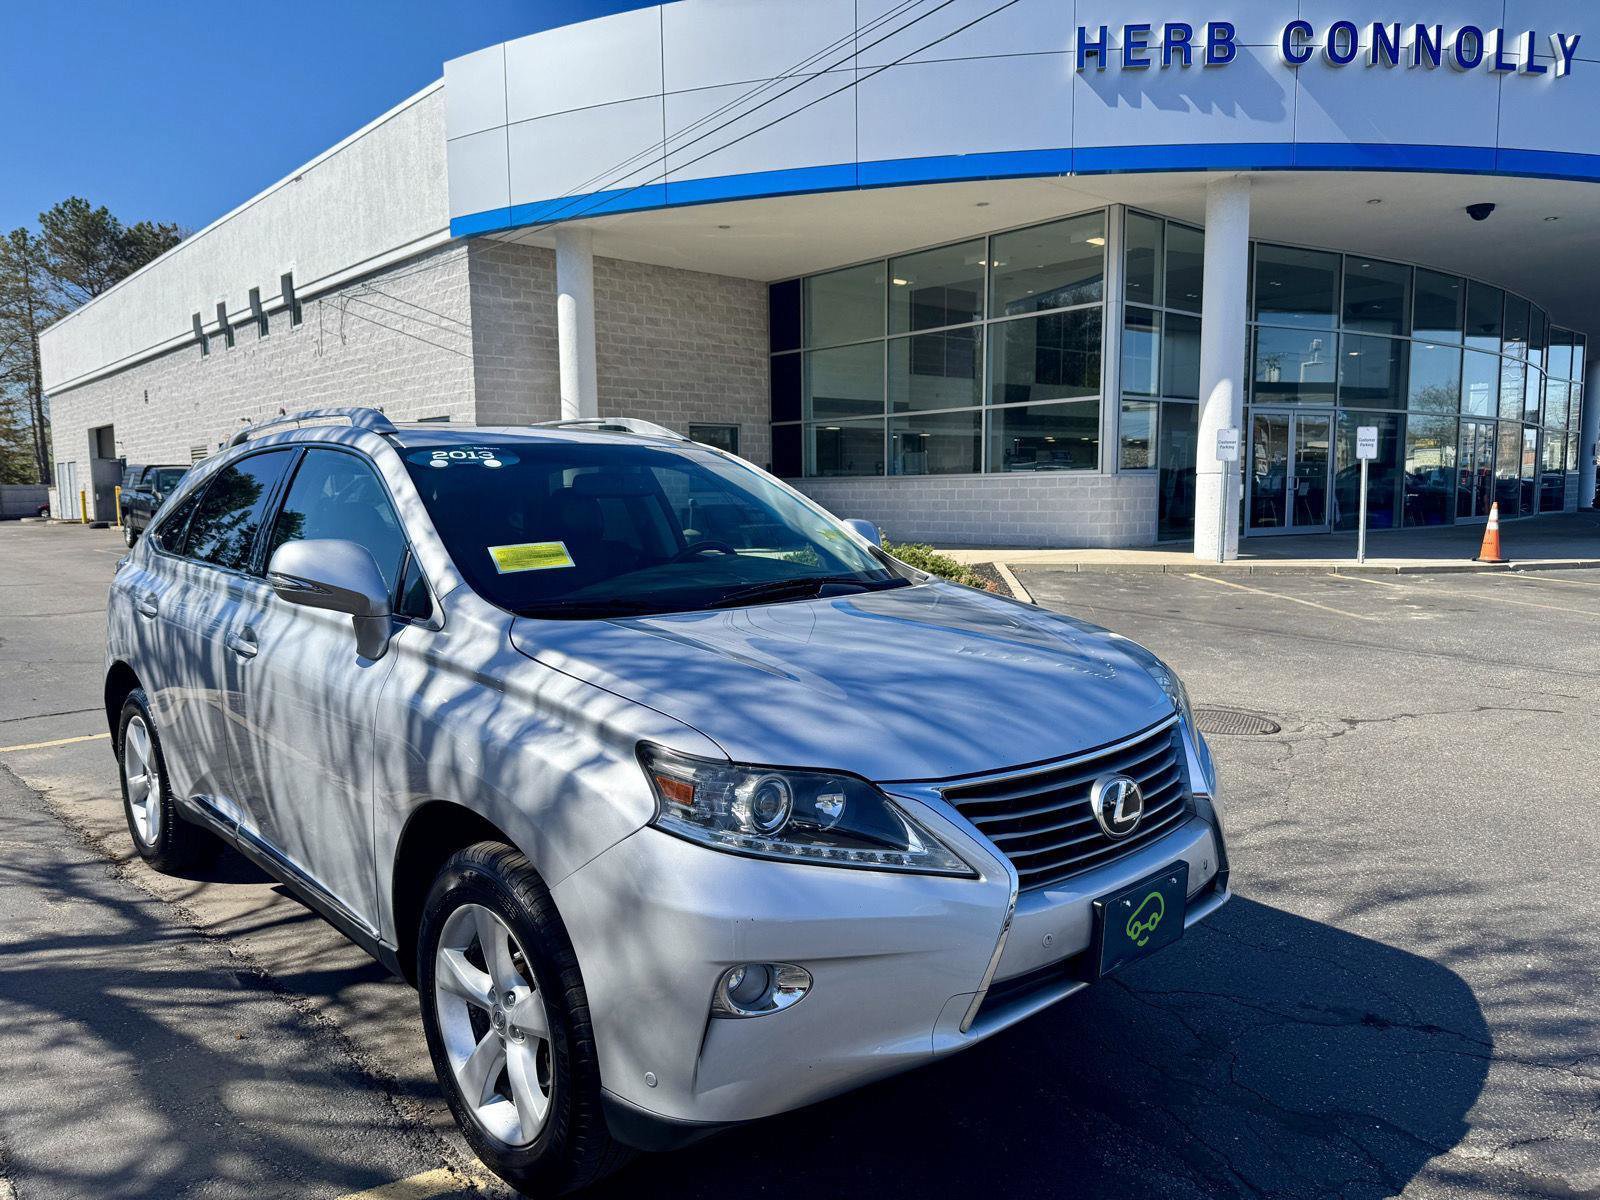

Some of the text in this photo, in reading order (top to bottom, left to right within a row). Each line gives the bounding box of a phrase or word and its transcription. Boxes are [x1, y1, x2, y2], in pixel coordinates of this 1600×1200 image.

[1076, 20, 1581, 78] HERB CONNOLLY
[432, 451, 494, 460] 2013
